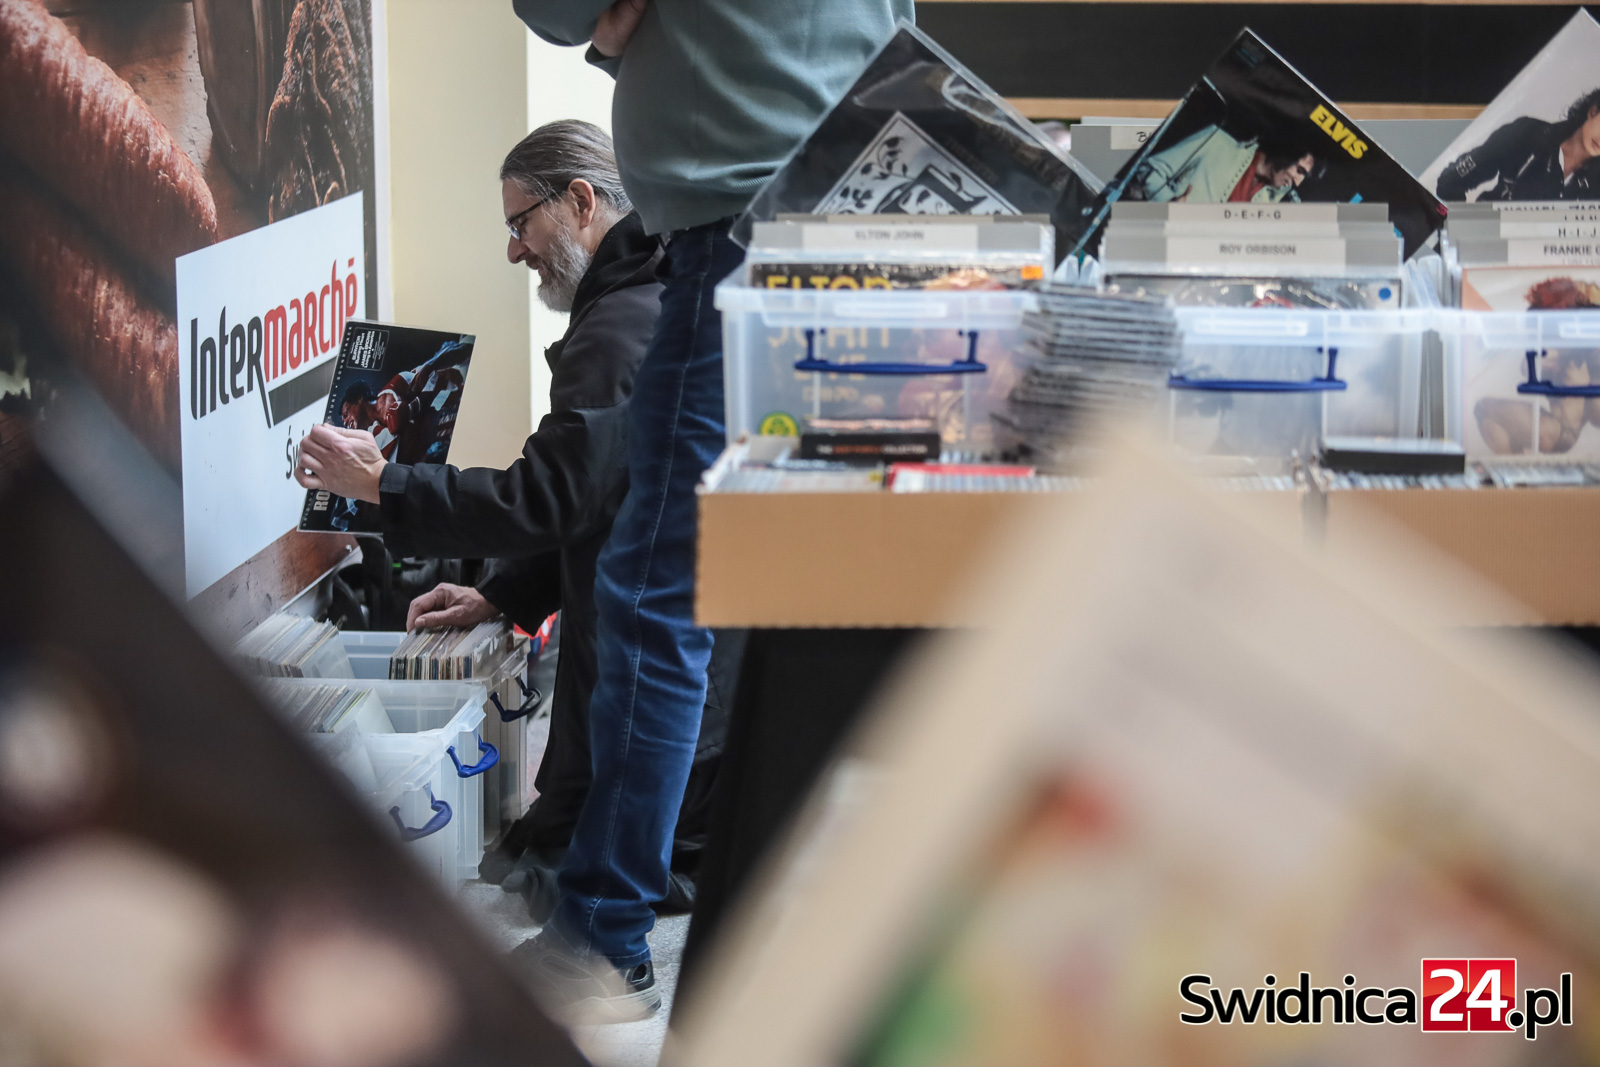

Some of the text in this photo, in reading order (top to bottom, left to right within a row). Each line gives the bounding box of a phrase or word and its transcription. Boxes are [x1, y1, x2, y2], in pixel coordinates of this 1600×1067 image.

[1309, 103, 1369, 160] ELVIS
[855, 229, 925, 240] ELTON JOHN
[1219, 244, 1297, 256] ROY ORBISON
[1543, 244, 1592, 257] FRANKIE
[313, 491, 330, 511] RO
